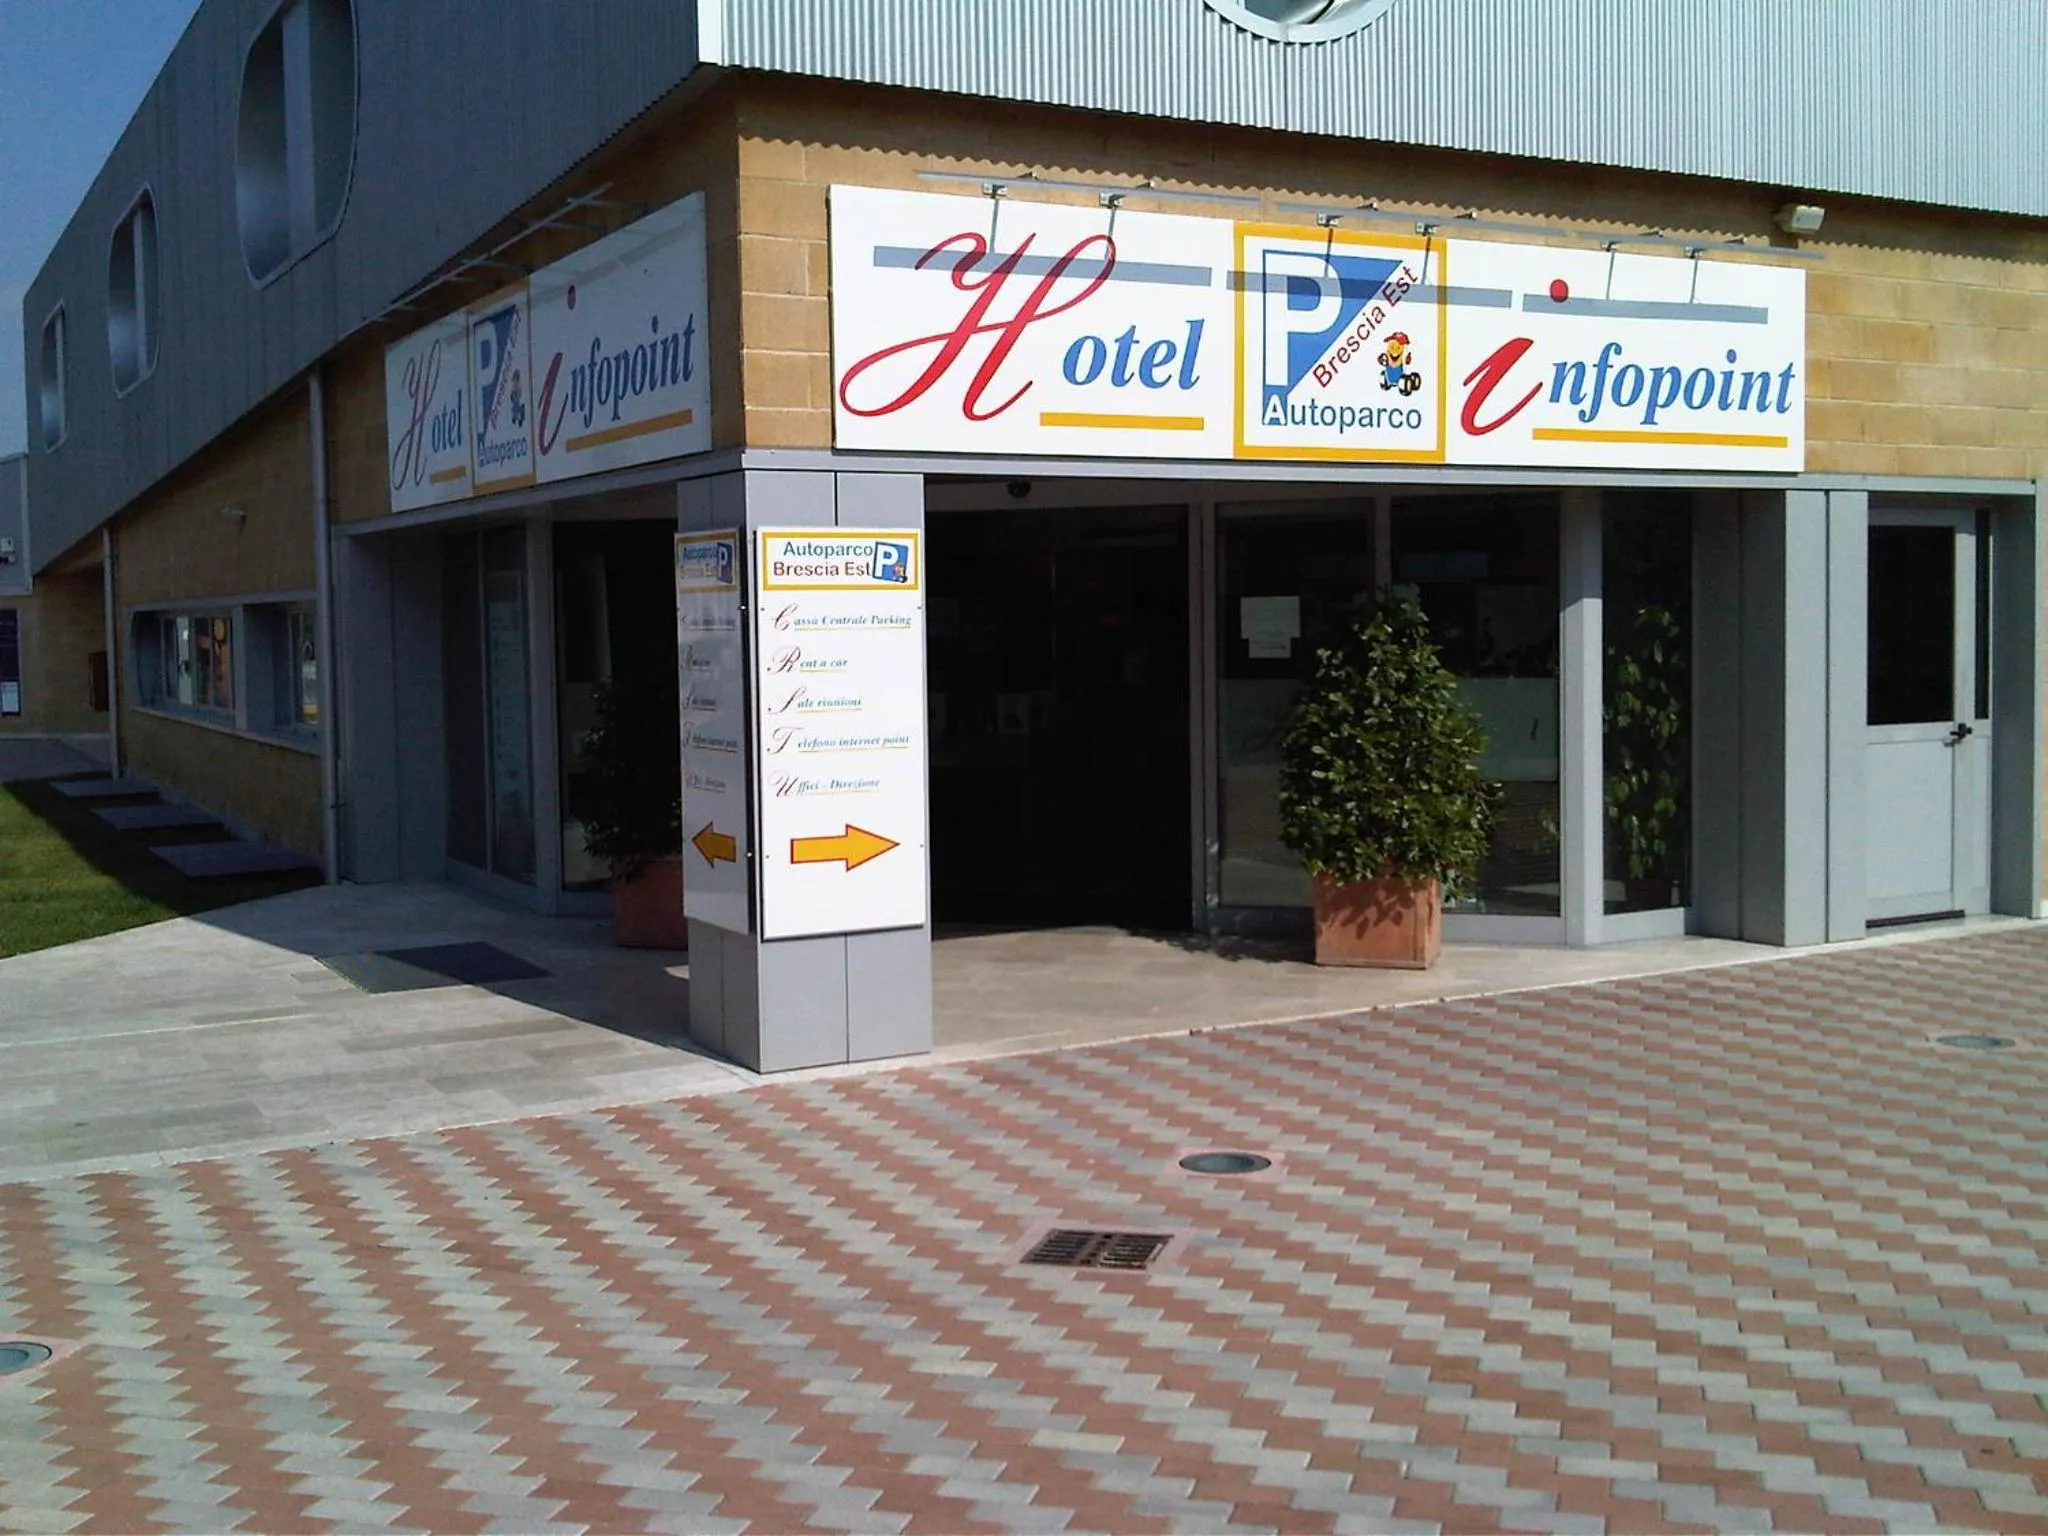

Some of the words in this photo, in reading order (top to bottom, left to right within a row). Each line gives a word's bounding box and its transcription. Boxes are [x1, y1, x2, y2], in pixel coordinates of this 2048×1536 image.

[839, 231, 1205, 421] Hotel
[1264, 250, 1342, 387] P
[1311, 303, 1388, 389] Brescia
[1380, 264, 1419, 306] Est
[391, 337, 463, 491] Hotel
[1261, 392, 1421, 434] Autoparco
[783, 541, 872, 561] Autoparco
[773, 561, 839, 577] Brescia
[844, 561, 872, 577] Est
[771, 603, 818, 631] Cassa
[821, 615, 867, 626] Centrale
[870, 615, 912, 627] Parking
[767, 644, 817, 675] Rent
[819, 660, 827, 668] a
[831, 659, 848, 668] car
[767, 686, 814, 715] Sale
[767, 726, 837, 754] Telefono
[839, 736, 881, 747] internet
[882, 735, 910, 749] point
[768, 769, 820, 798] Uffici
[830, 779, 881, 790] Direzione
